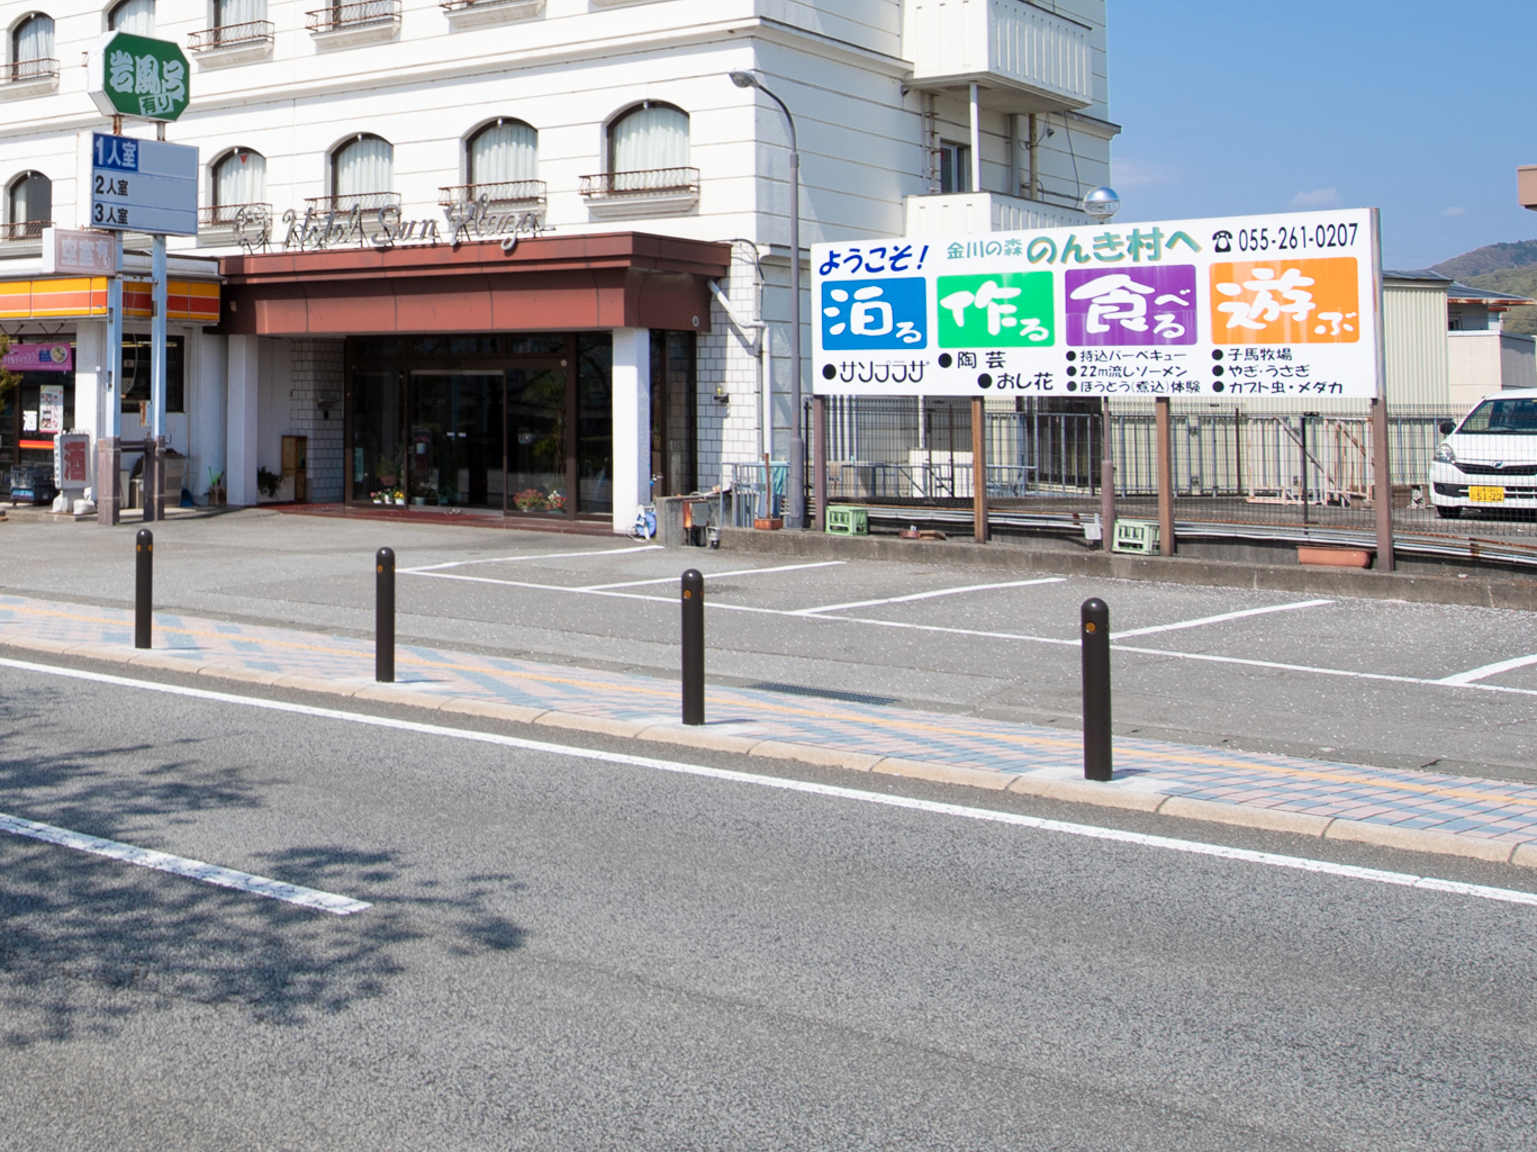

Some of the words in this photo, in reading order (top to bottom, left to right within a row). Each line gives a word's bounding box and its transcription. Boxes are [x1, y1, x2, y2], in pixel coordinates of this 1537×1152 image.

[96, 136, 136, 168] 1人室
[95, 175, 129, 197] 2人室
[95, 203, 129, 225] 3人室
[282, 203, 361, 252] Hotel
[371, 204, 438, 246] Sun
[446, 193, 556, 250] Plaza
[1238, 223, 1358, 251] 055-261-0207
[819, 244, 930, 276] ようこそ!
[823, 285, 922, 344] 泊る
[939, 280, 1050, 342] 作る
[1069, 273, 1191, 339] 食べる
[1215, 268, 1357, 336] 遊ぶ
[1080, 349, 1187, 363] 持込バーベキュー
[1228, 348, 1293, 361] 子馬牧場
[839, 359, 930, 383] サンプラザ
[996, 372, 1054, 391] おし花
[64, 441, 87, 482] 酒
